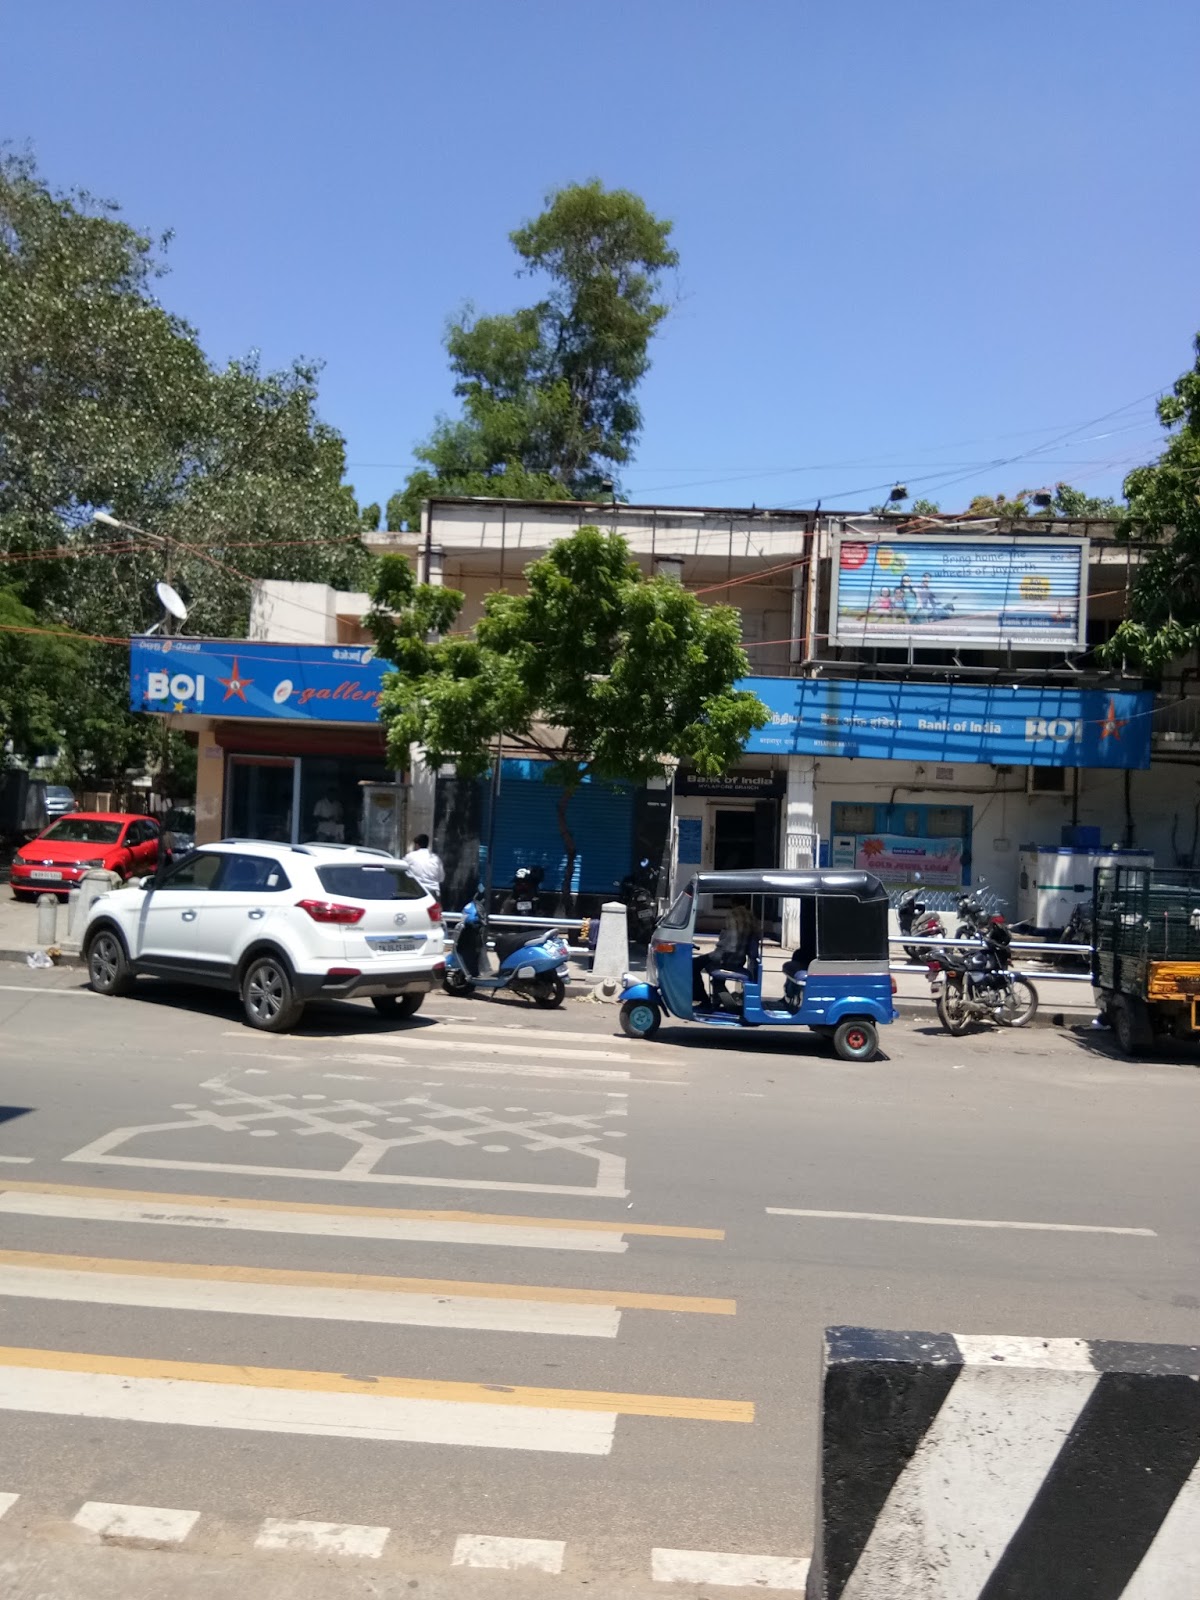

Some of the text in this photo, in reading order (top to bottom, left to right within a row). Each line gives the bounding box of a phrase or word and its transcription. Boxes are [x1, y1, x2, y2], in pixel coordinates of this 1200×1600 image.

[942, 554, 971, 565] Bring
[975, 552, 1004, 562] home
[935, 564, 971, 577] wheels
[974, 566, 986, 576] of
[992, 566, 1008, 577] joy
[148, 672, 205, 701] BOI
[918, 718, 1001, 735] Bank of India
[1025, 716, 1084, 744] BOI
[687, 775, 773, 785] Bank of India
[868, 860, 949, 872] GOLD JEWEL LOAN
